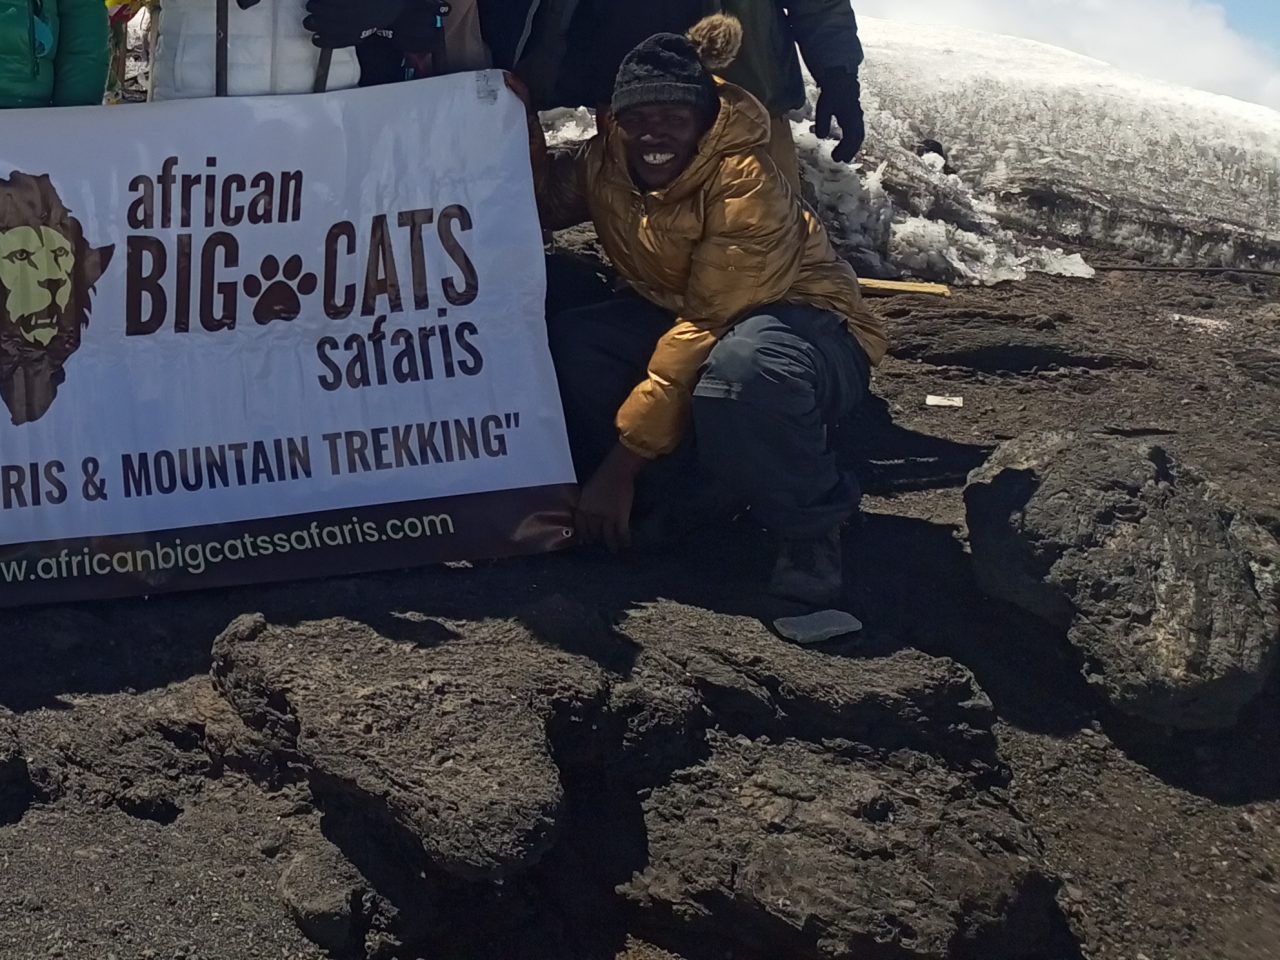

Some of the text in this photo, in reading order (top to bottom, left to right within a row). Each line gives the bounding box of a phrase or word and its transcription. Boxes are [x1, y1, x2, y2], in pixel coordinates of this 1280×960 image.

[127, 155, 304, 229] african
[125, 203, 480, 338] BIG CATS
[316, 307, 484, 392] safaris
[82, 456, 108, 502] &
[121, 434, 313, 499] MOUNTAIN
[321, 411, 521, 477] TREKKING"
